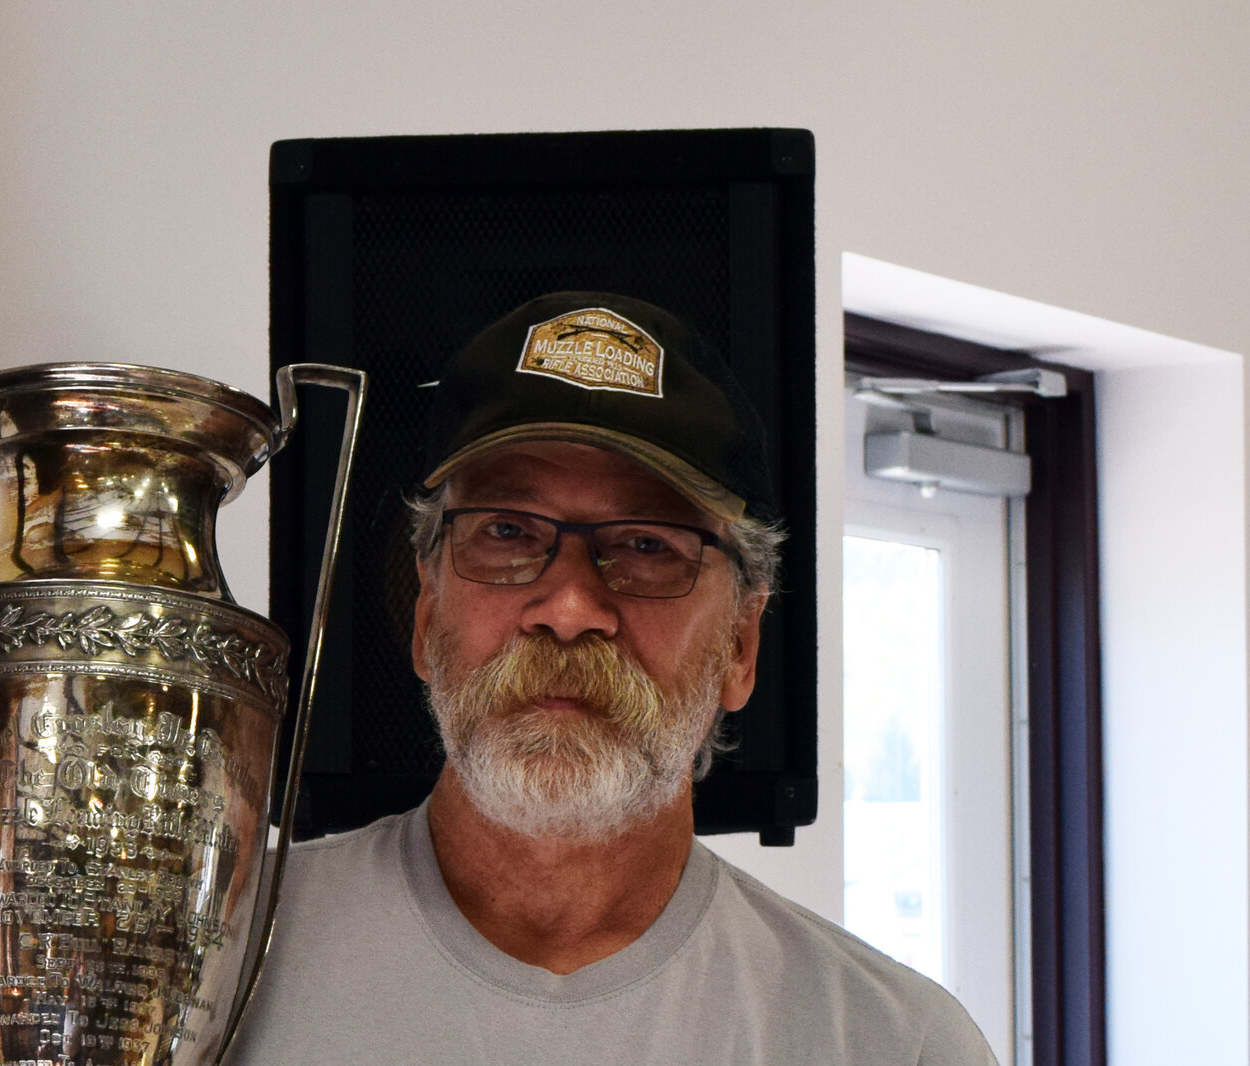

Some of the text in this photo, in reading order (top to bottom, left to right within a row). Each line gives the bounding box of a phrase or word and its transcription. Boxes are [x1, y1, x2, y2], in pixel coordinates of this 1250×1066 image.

[576, 316, 627, 334] NATIONAL
[534, 340, 593, 355] MUZZLE
[596, 341, 655, 376] LOADING
[542, 358, 572, 374] RIFLE
[574, 362, 644, 388] ASSOCIATION
[67, 1009, 89, 1028] TO
